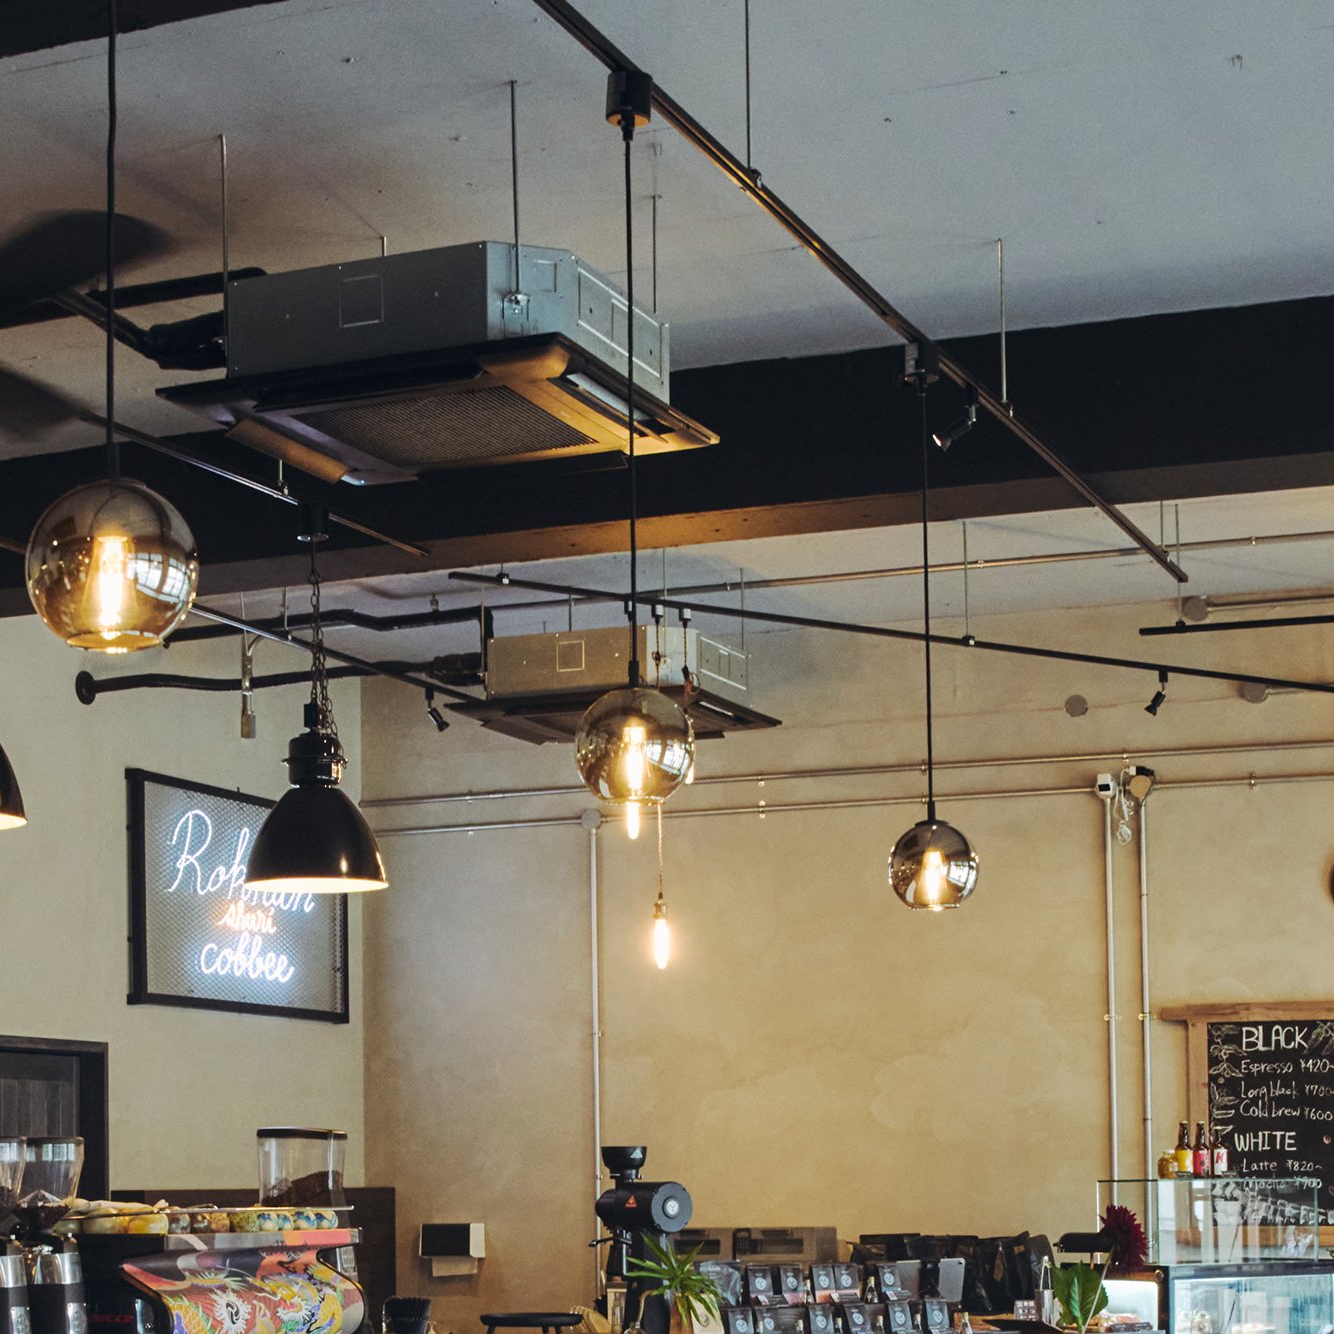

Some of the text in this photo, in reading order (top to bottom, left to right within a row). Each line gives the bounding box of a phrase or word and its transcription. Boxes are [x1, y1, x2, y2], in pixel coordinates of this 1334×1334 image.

[1241, 1024, 1309, 1052] BLACK
[1241, 1059, 1293, 1076] Espresso
[1240, 1081, 1268, 1102] Long
[1239, 1099, 1334, 1121] Cold brew ¥600
[1234, 1131, 1298, 1153] WHITE
[1241, 1158, 1278, 1173] Latte
